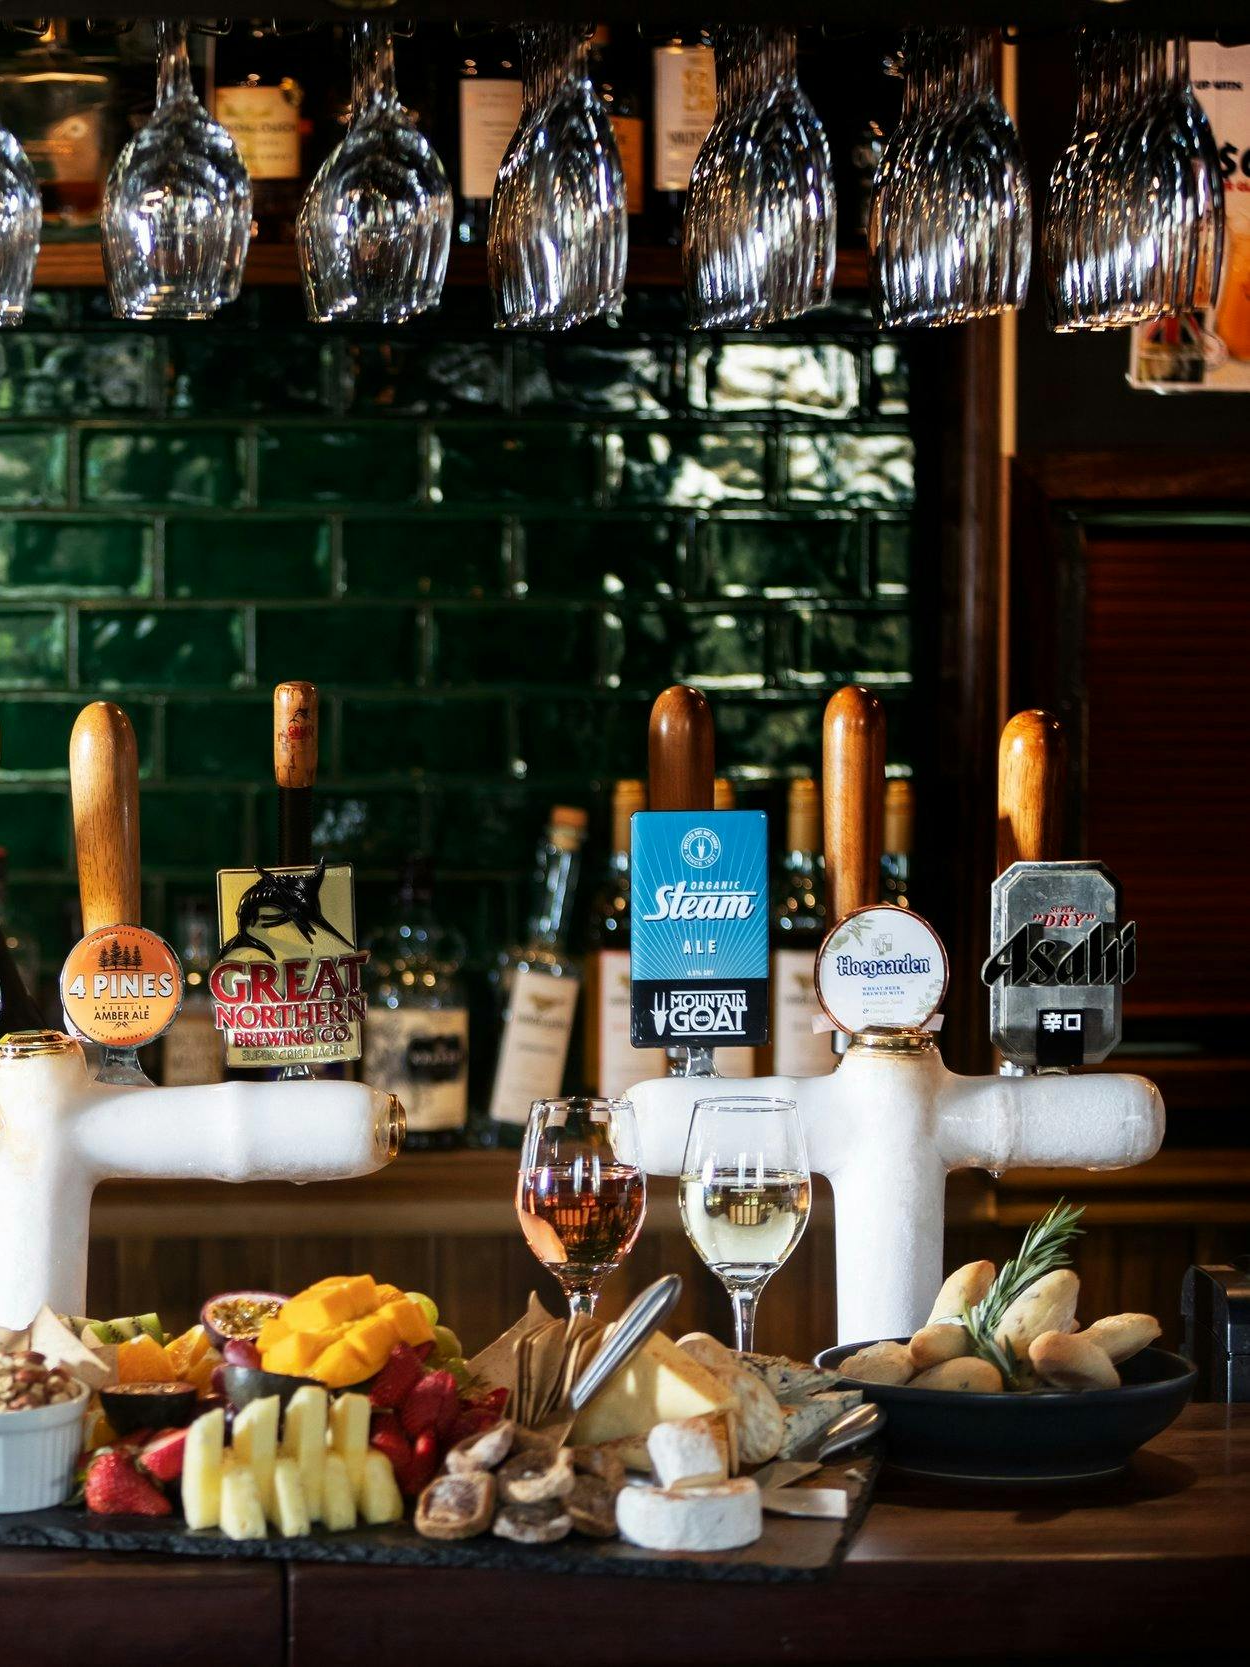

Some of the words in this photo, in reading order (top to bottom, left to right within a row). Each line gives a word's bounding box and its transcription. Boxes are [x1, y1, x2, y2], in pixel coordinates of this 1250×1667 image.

[690, 880, 741, 891] ORGANIC
[642, 880, 757, 922] Steam
[1050, 905, 1076, 914] SUPER
[683, 940, 718, 955] ALE
[981, 921, 1137, 987] Asahi
[837, 953, 930, 978] Hoegaarden
[69, 974, 86, 999] 4
[93, 973, 174, 999] PINES
[210, 951, 371, 1005] GREAT
[670, 994, 747, 1008] MOUNTAIN
[94, 1011, 129, 1021] AMBER
[132, 1011, 150, 1020] ALE
[215, 995, 368, 1030] NORTHERN
[669, 1006, 748, 1032] GOAT
[1042, 1013, 1081, 1033] 辛口
[234, 1029, 316, 1047] BREWING
[319, 1026, 353, 1043] CO.
[242, 1049, 276, 1061] SUPER
[278, 1048, 308, 1060] CRISP
[312, 1045, 345, 1058] LAGER
